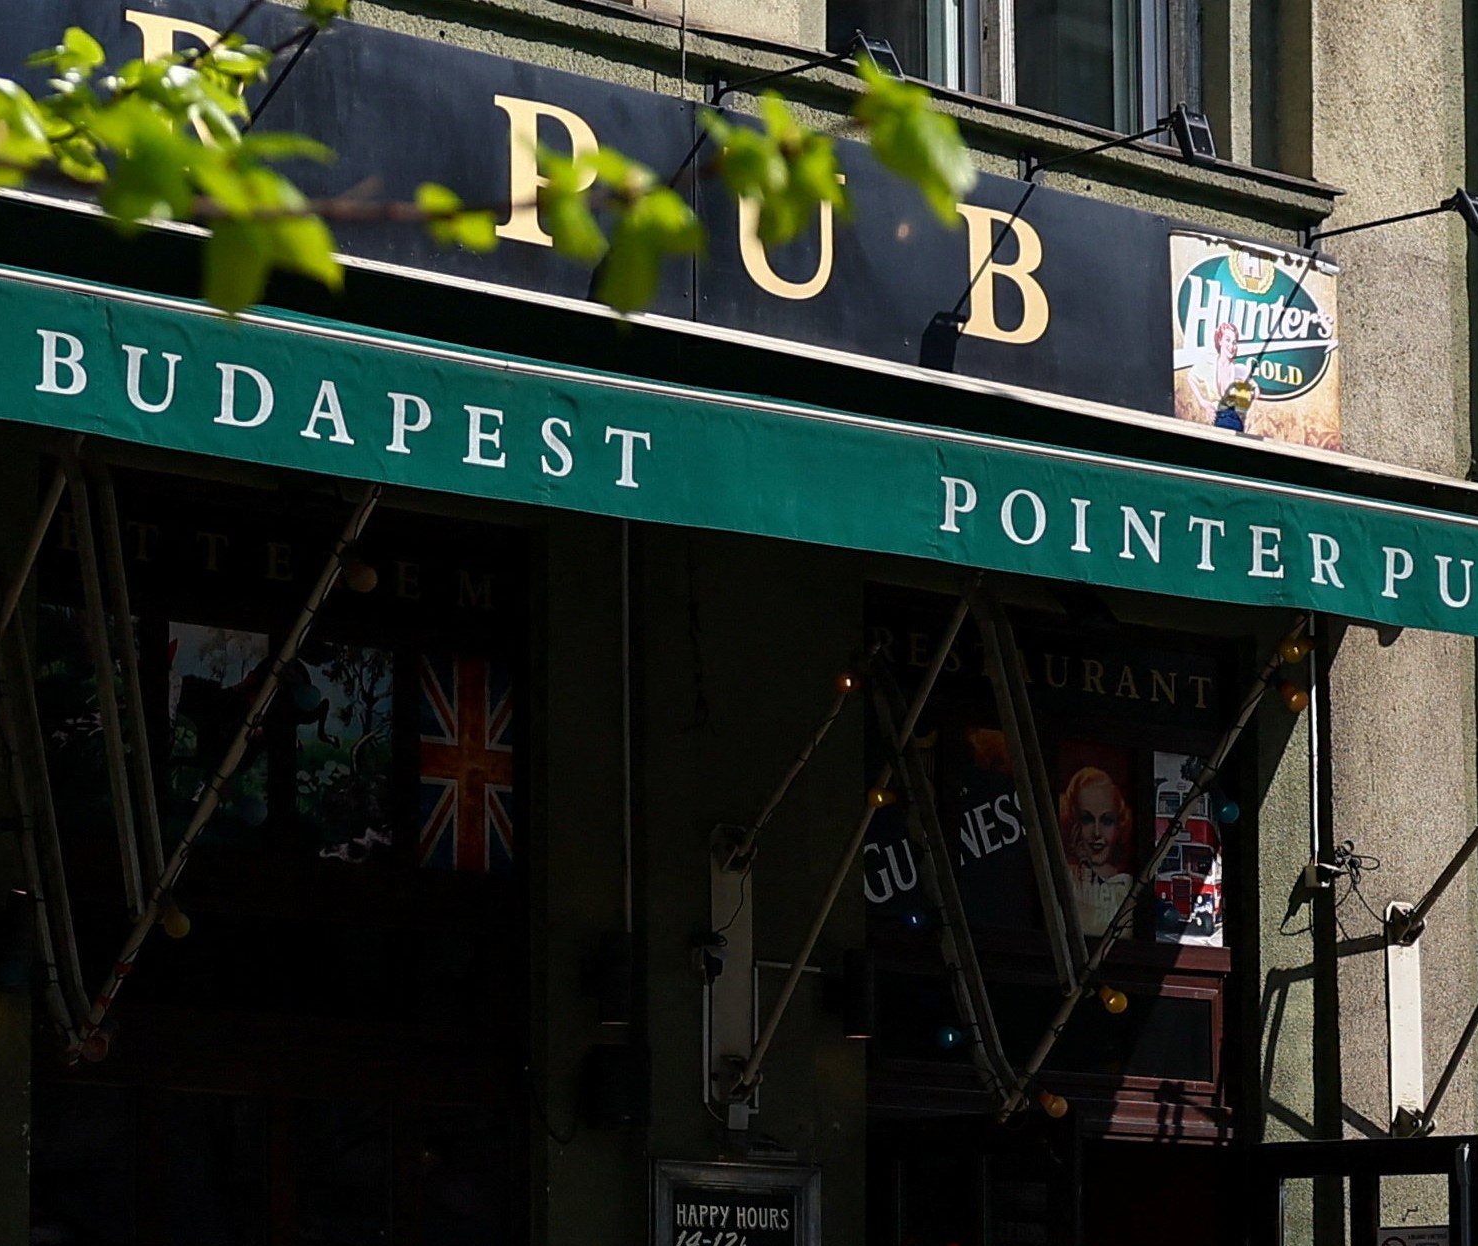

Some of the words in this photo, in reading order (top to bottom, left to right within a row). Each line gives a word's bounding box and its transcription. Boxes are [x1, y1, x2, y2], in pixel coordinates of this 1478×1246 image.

[495, 95, 1050, 344] PUB
[1182, 274, 1335, 349] Hunter's
[34, 328, 652, 490] BUDAPEST
[1246, 357, 1304, 386] GOLD
[938, 475, 1346, 590] POINTER
[676, 1203, 730, 1229] HAPPY
[736, 1206, 790, 1231] HOURS
